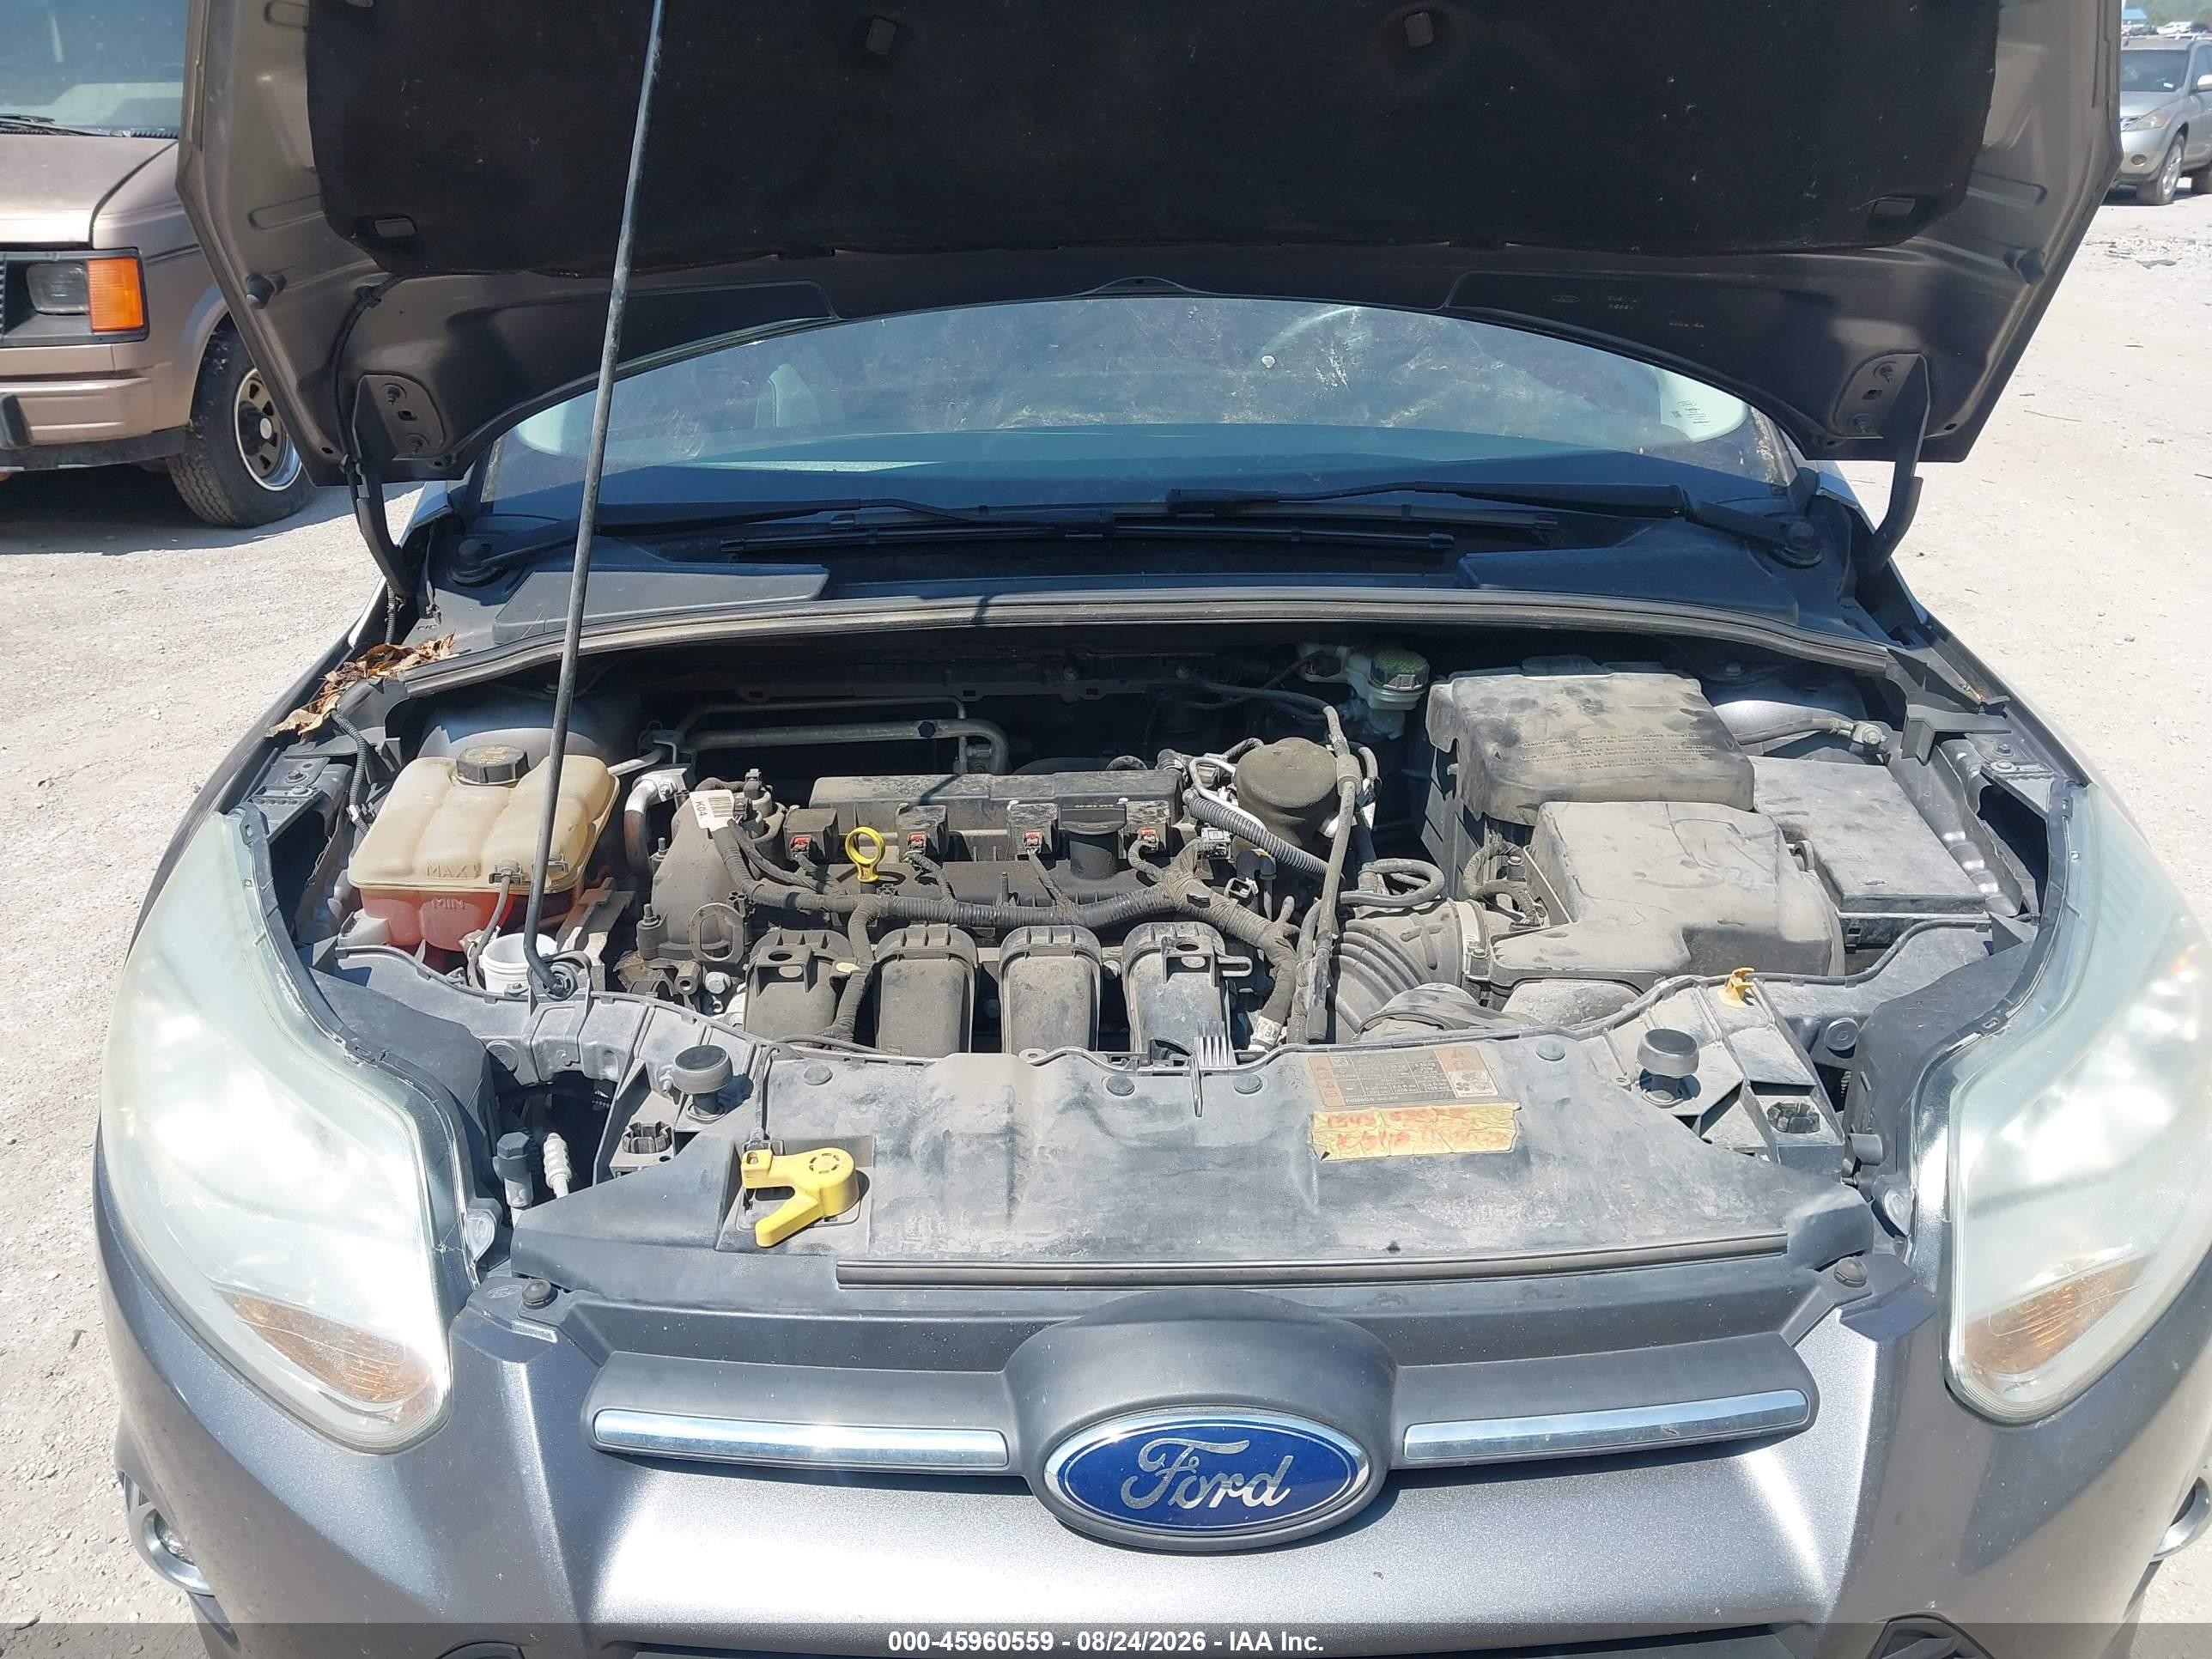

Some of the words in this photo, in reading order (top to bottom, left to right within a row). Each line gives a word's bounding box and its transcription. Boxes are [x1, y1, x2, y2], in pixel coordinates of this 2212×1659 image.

[694, 800, 708, 818] K04
[427, 863, 468, 878] MAX
[431, 897, 466, 910] MIN
[1121, 1437, 1295, 1510] Ford
